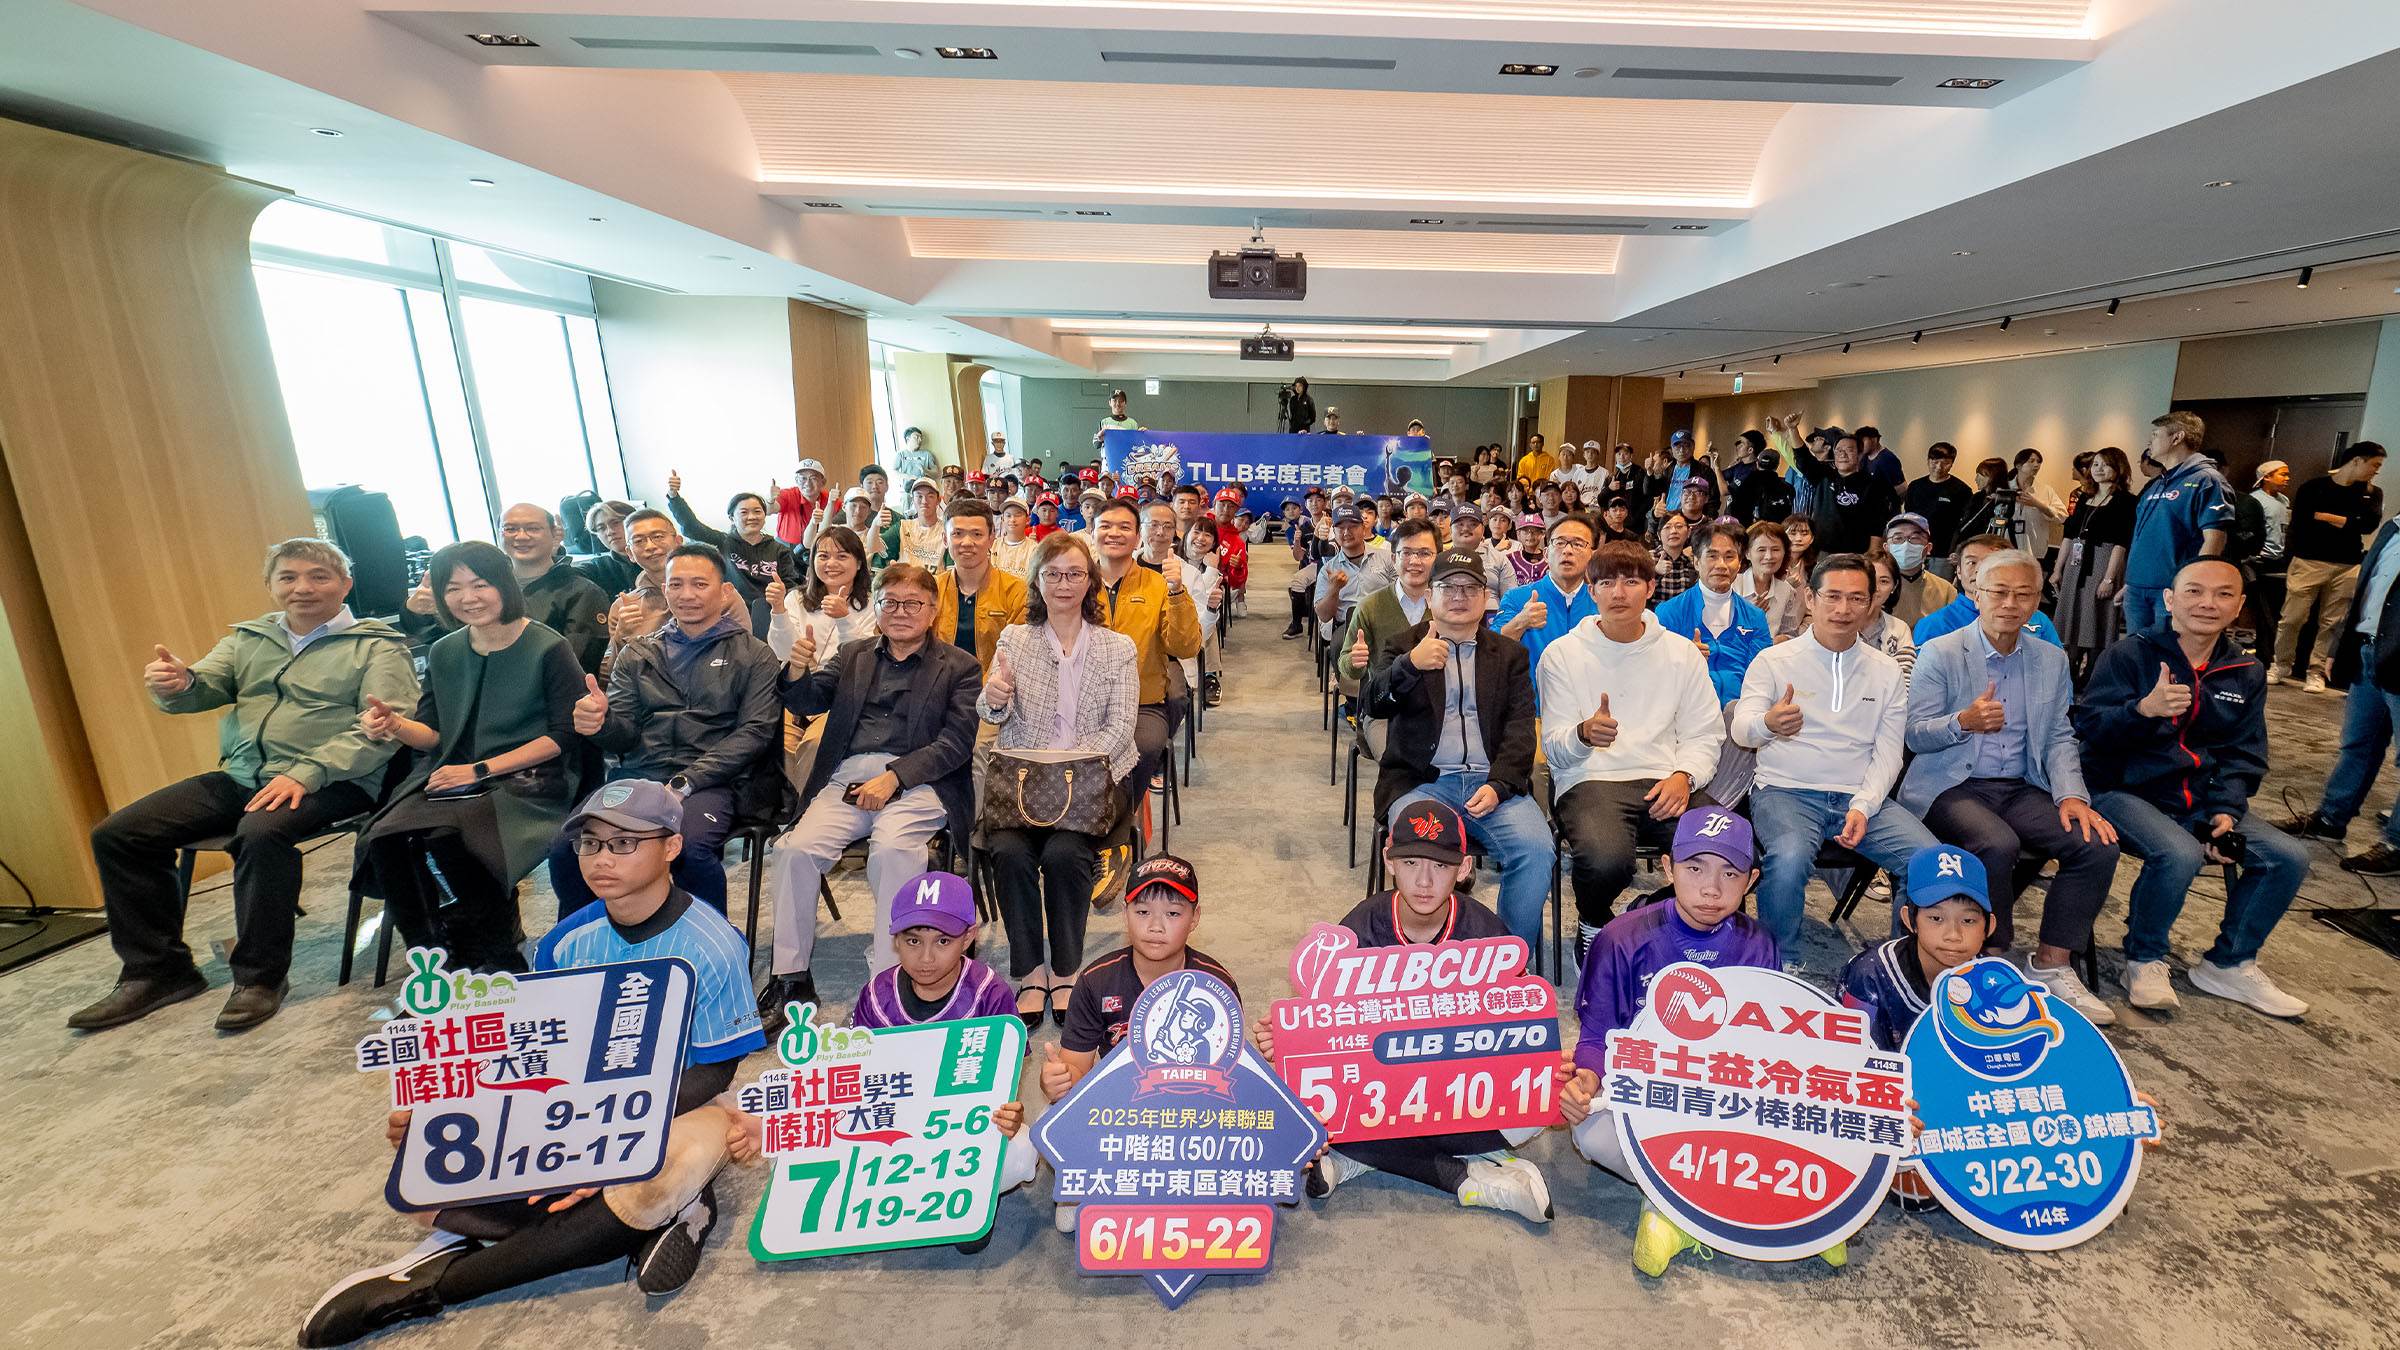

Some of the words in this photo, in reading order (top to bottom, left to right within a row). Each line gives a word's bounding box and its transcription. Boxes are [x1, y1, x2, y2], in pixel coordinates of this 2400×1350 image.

[1187, 462, 1368, 486] TLLB年度記者會
[1525, 514, 1534, 522] M
[915, 879, 941, 905] M
[1332, 944, 1521, 998] TLLBCUP
[450, 1002, 471, 1012] Play
[474, 996, 516, 1009] Baseball
[603, 972, 654, 1073] 全國賽
[1661, 990, 1863, 1046] MAXE
[386, 1022, 418, 1035] 114年
[1133, 1024, 1142, 1044] 2025
[1327, 1033, 1370, 1050] 114年
[1385, 1034, 1445, 1058] LLB
[1453, 1025, 1548, 1052] 50/70
[816, 1054, 835, 1063] Play
[836, 1049, 872, 1061] Baseball
[950, 1026, 991, 1087] 預賽
[1161, 1069, 1207, 1081] TAIPEI
[1612, 1036, 1905, 1112] 萬士益冷氣盃
[1871, 1058, 1899, 1072] 114年
[395, 1050, 549, 1106] 棒球大賽
[763, 1072, 788, 1083] 114年
[544, 1089, 652, 1131] 9-10
[1088, 1108, 1275, 1131] 2025年世界少棒聯盟
[1609, 1075, 1905, 1149] 全國青少棒錦標賽
[1966, 1084, 2067, 1119] 中華電信
[766, 1101, 896, 1153] 棒球大賽
[922, 1105, 991, 1140] 5-6
[1911, 1110, 2153, 1155] 國城盃全國少棒錦標賽
[423, 1112, 486, 1186] 8
[506, 1130, 646, 1177] 16-17
[1099, 1133, 1264, 1162] 中階組(50/70)
[861, 1146, 982, 1188] 12-13
[1060, 1168, 1295, 1198] 亞太暨中東區資格賽
[1668, 1143, 1828, 1201] 4/12-20
[1965, 1150, 2103, 1197] 3/22-30
[788, 1159, 841, 1234] 7
[851, 1188, 973, 1230] 19-20
[2020, 1205, 2070, 1229] 114年
[1089, 1216, 1263, 1261] 6/15-22
